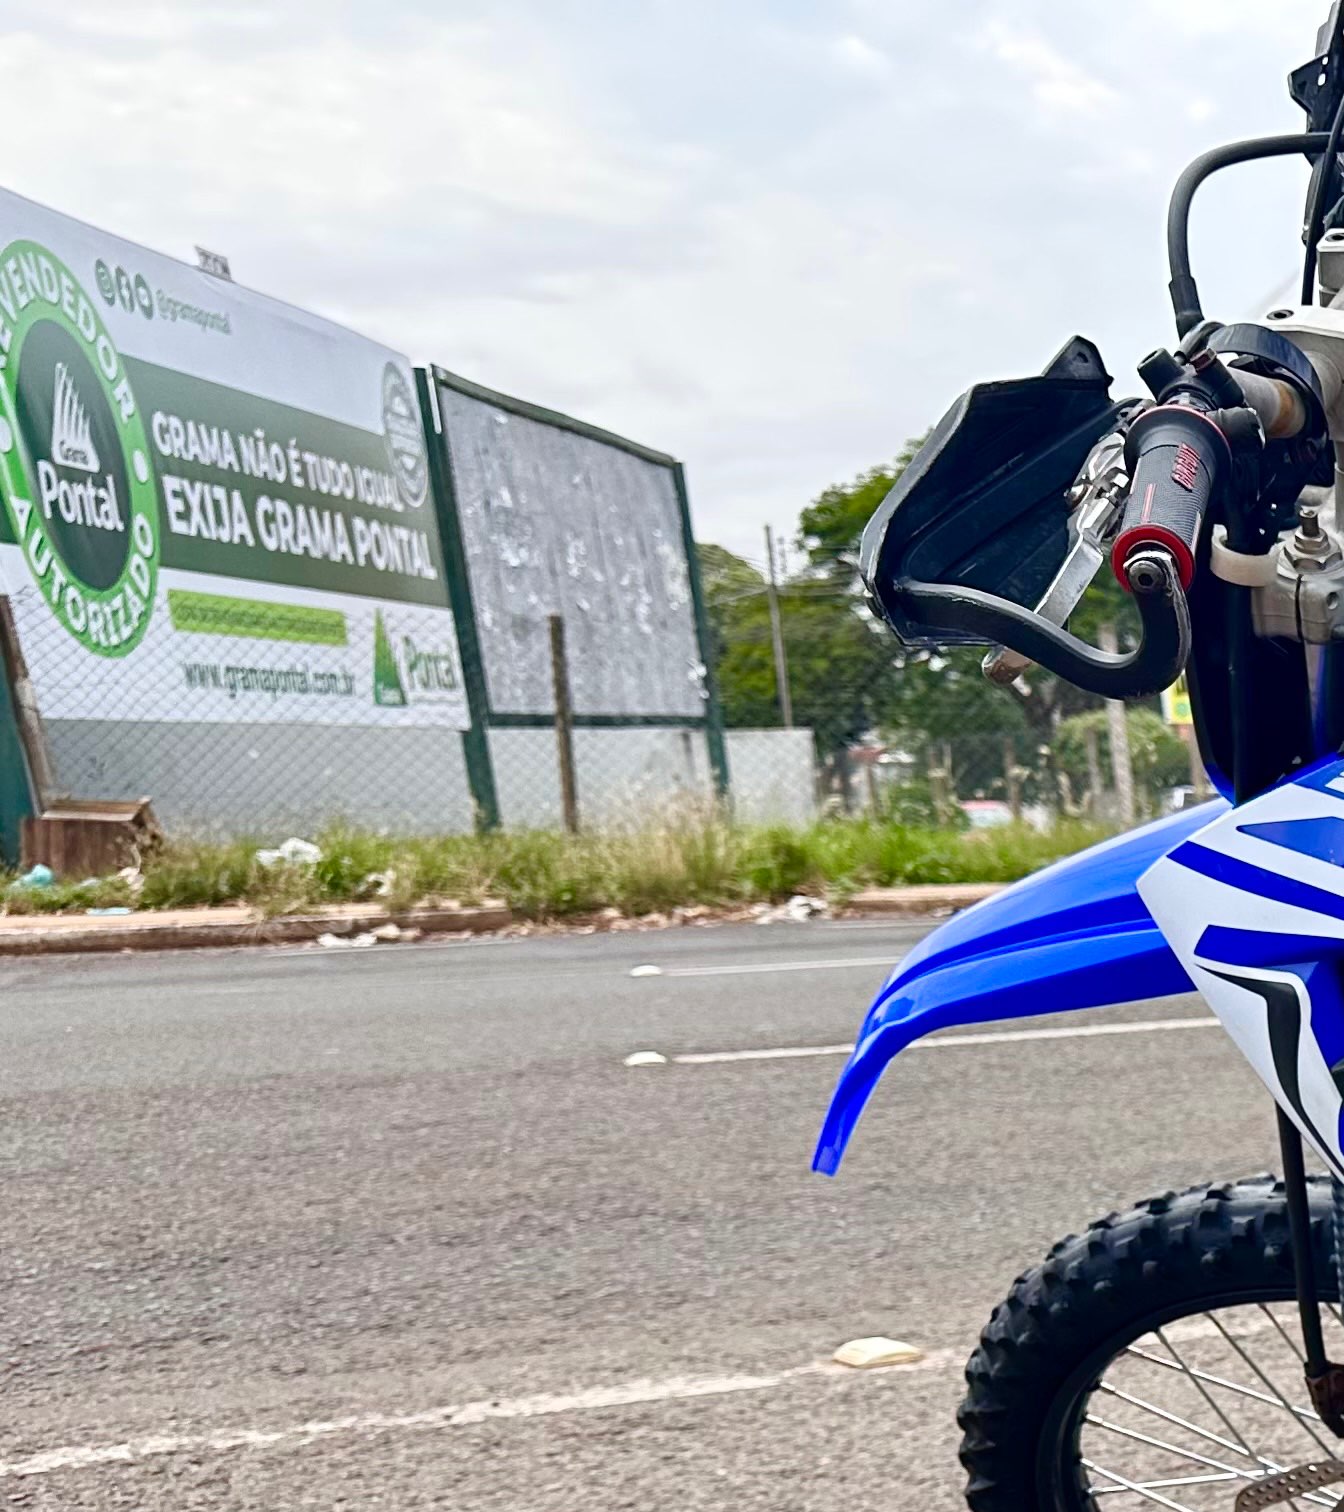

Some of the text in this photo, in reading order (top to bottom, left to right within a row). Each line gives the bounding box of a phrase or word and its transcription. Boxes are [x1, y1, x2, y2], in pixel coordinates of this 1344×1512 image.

[0, 252, 135, 424] VENDEDOR
[37, 458, 125, 532] Pontal
[152, 411, 240, 472] GRAMA
[239, 428, 287, 484] NÃO
[286, 437, 305, 488] É
[302, 451, 355, 500] TUDO
[9, 494, 154, 647] AUTORIZADO
[162, 474, 438, 581] EXIJA GRAMA PONTAL
